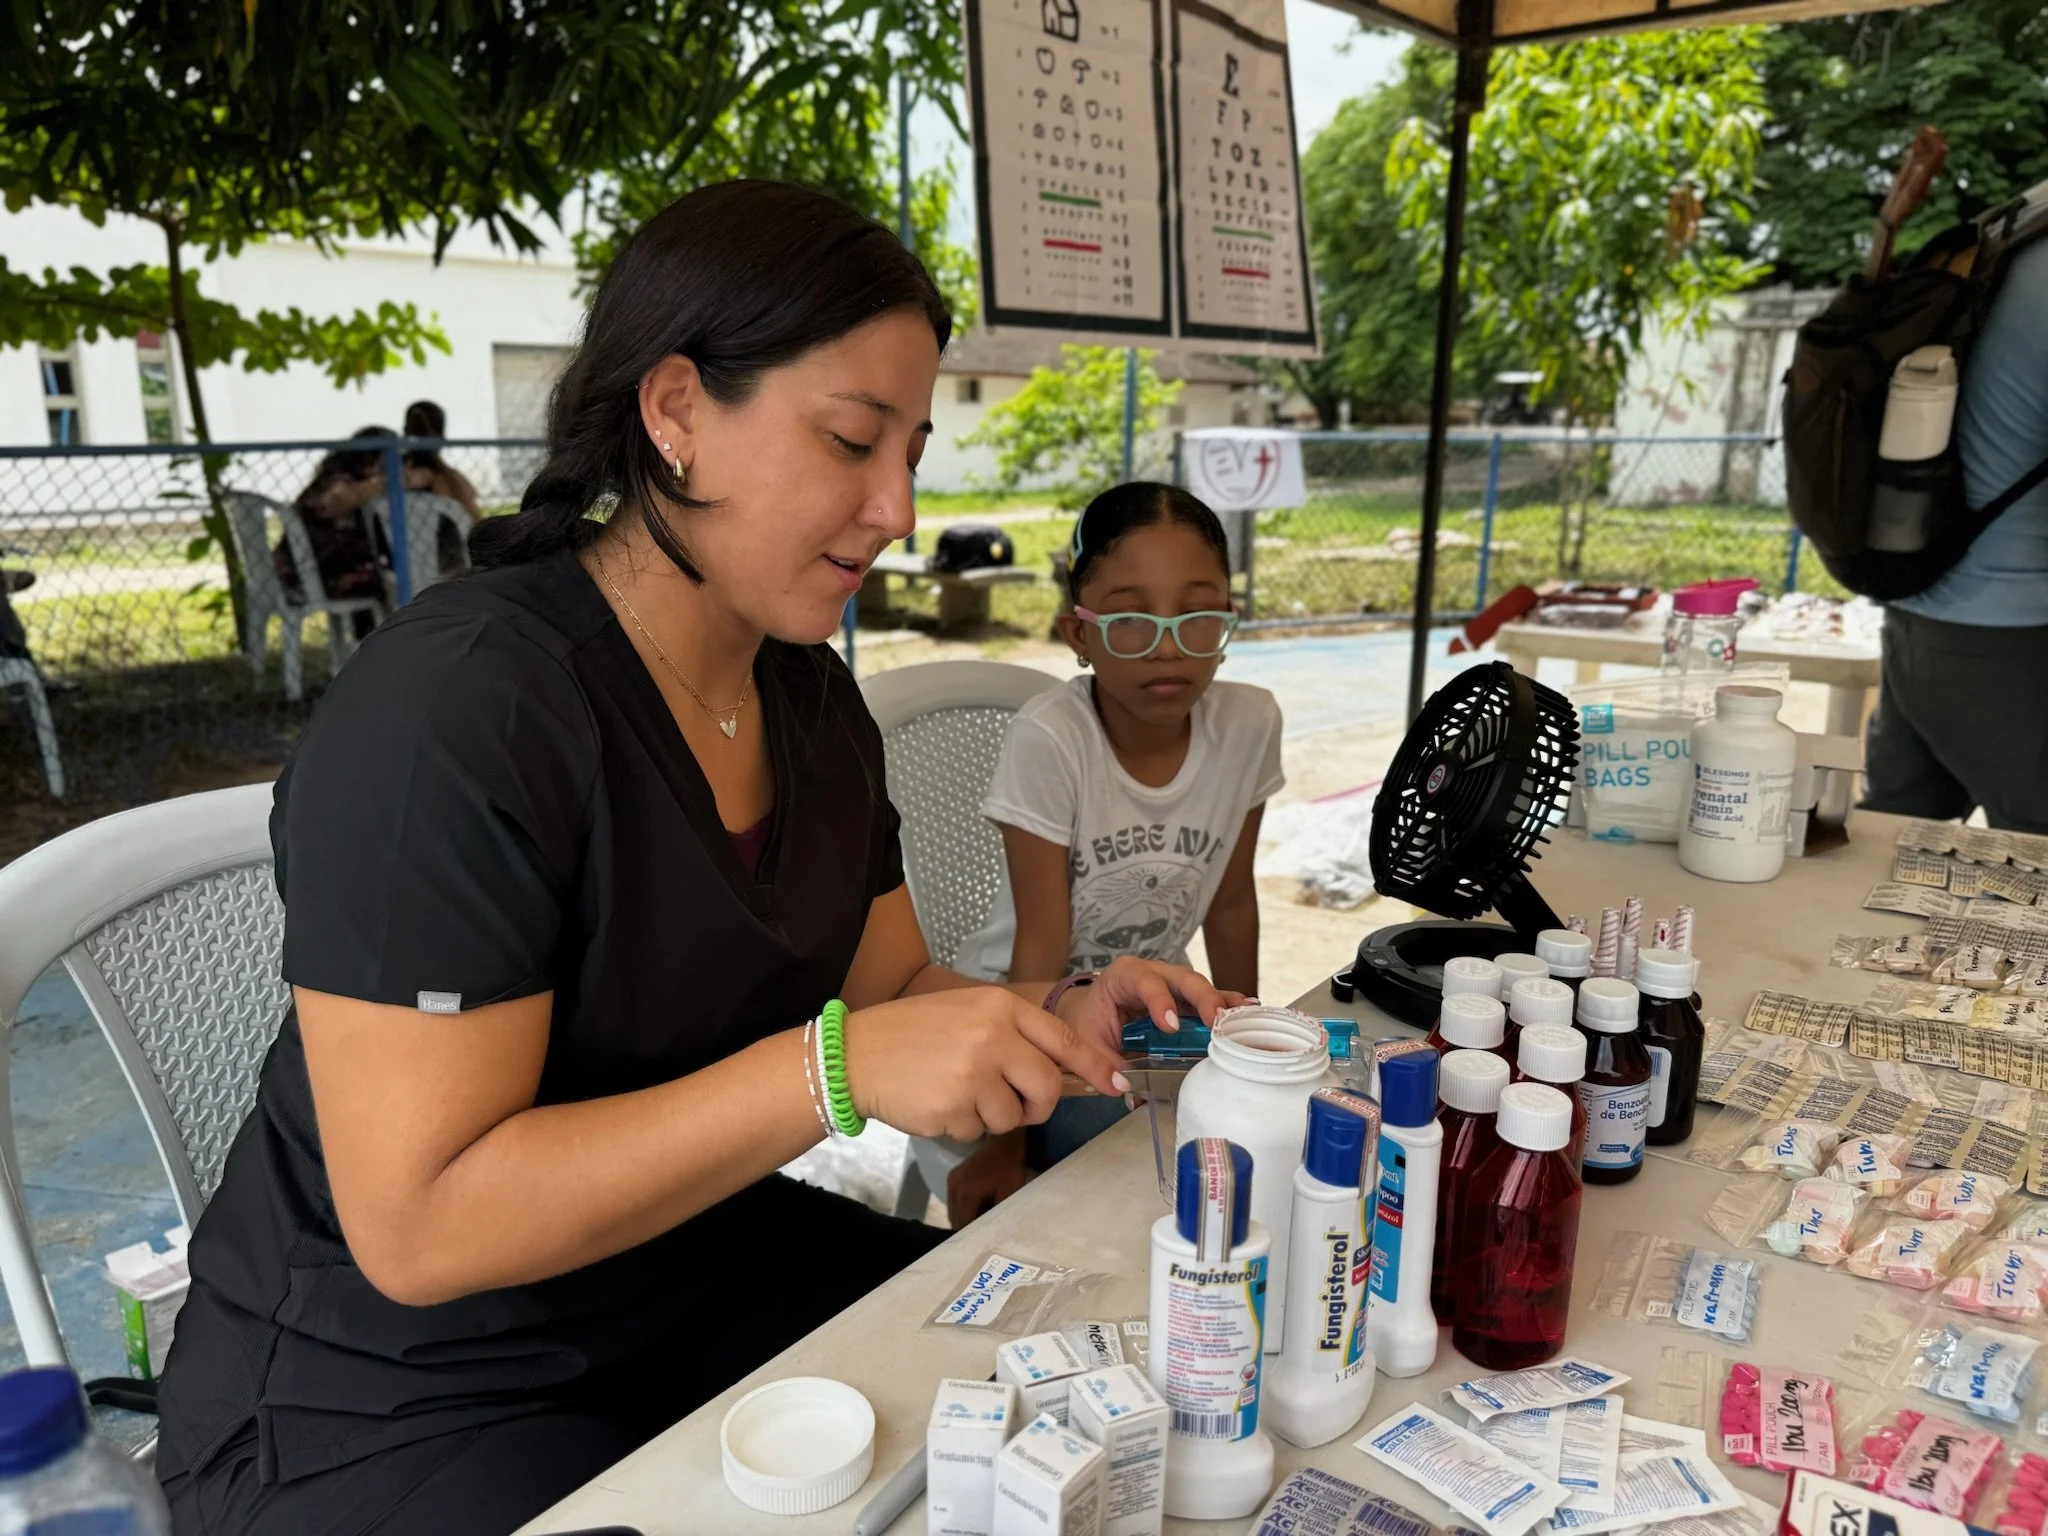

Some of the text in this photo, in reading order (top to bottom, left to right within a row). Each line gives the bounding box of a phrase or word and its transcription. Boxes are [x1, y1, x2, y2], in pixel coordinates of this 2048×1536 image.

[1223, 52, 1240, 98] E
[1231, 143, 1243, 162] O
[1583, 742, 1637, 762] PILL
[1584, 766, 1651, 788] BAGS
[1703, 767, 1750, 778] BLESSINGS
[1091, 824, 1166, 866] HERE
[423, 999, 457, 1011] Hanes
[1600, 1110, 1615, 1119] de
[1169, 1263, 1260, 1286] Fungisterol
[1321, 1233, 1349, 1350] Fungisterol
[1765, 1402, 1777, 1456] PILL POUCH
[1384, 1438, 1403, 1454] COLD
[1403, 1432, 1412, 1440] &
[1276, 1495, 1308, 1512] AG
[1284, 1487, 1348, 1517] Amoxicilina
[1264, 1512, 1297, 1531] AG
[1272, 1504, 1336, 1534] Amoxicilina
